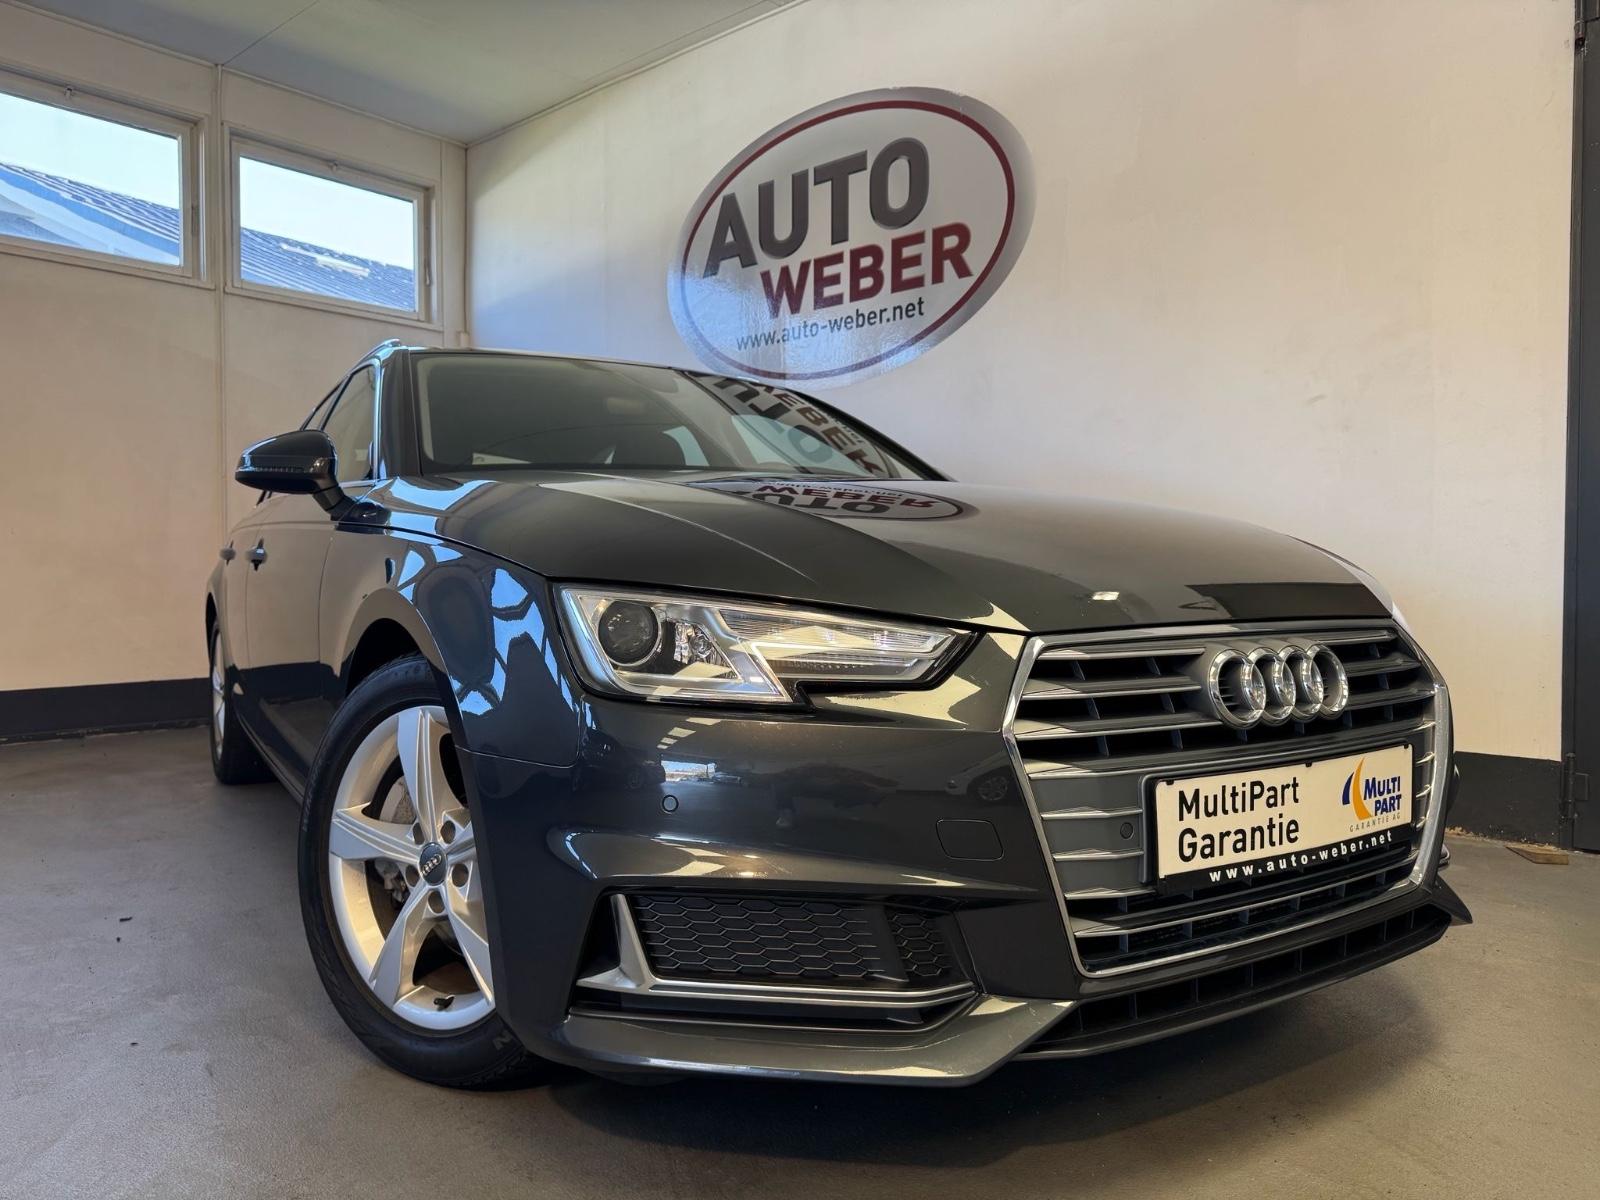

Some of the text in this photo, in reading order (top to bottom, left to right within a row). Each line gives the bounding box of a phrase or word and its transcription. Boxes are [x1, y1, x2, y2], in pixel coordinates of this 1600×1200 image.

[702, 137, 930, 279] AUTO
[760, 222, 973, 319] WEBER
[736, 296, 925, 351] www.auto-weber.net
[1178, 777, 1300, 822] MultiPart
[1363, 776, 1401, 801] MULTI
[1374, 794, 1402, 817] PART
[1178, 814, 1300, 862] Garantie
[1349, 812, 1401, 833] GARANTIE AG
[1209, 830, 1393, 882] www.auto-weber.net
